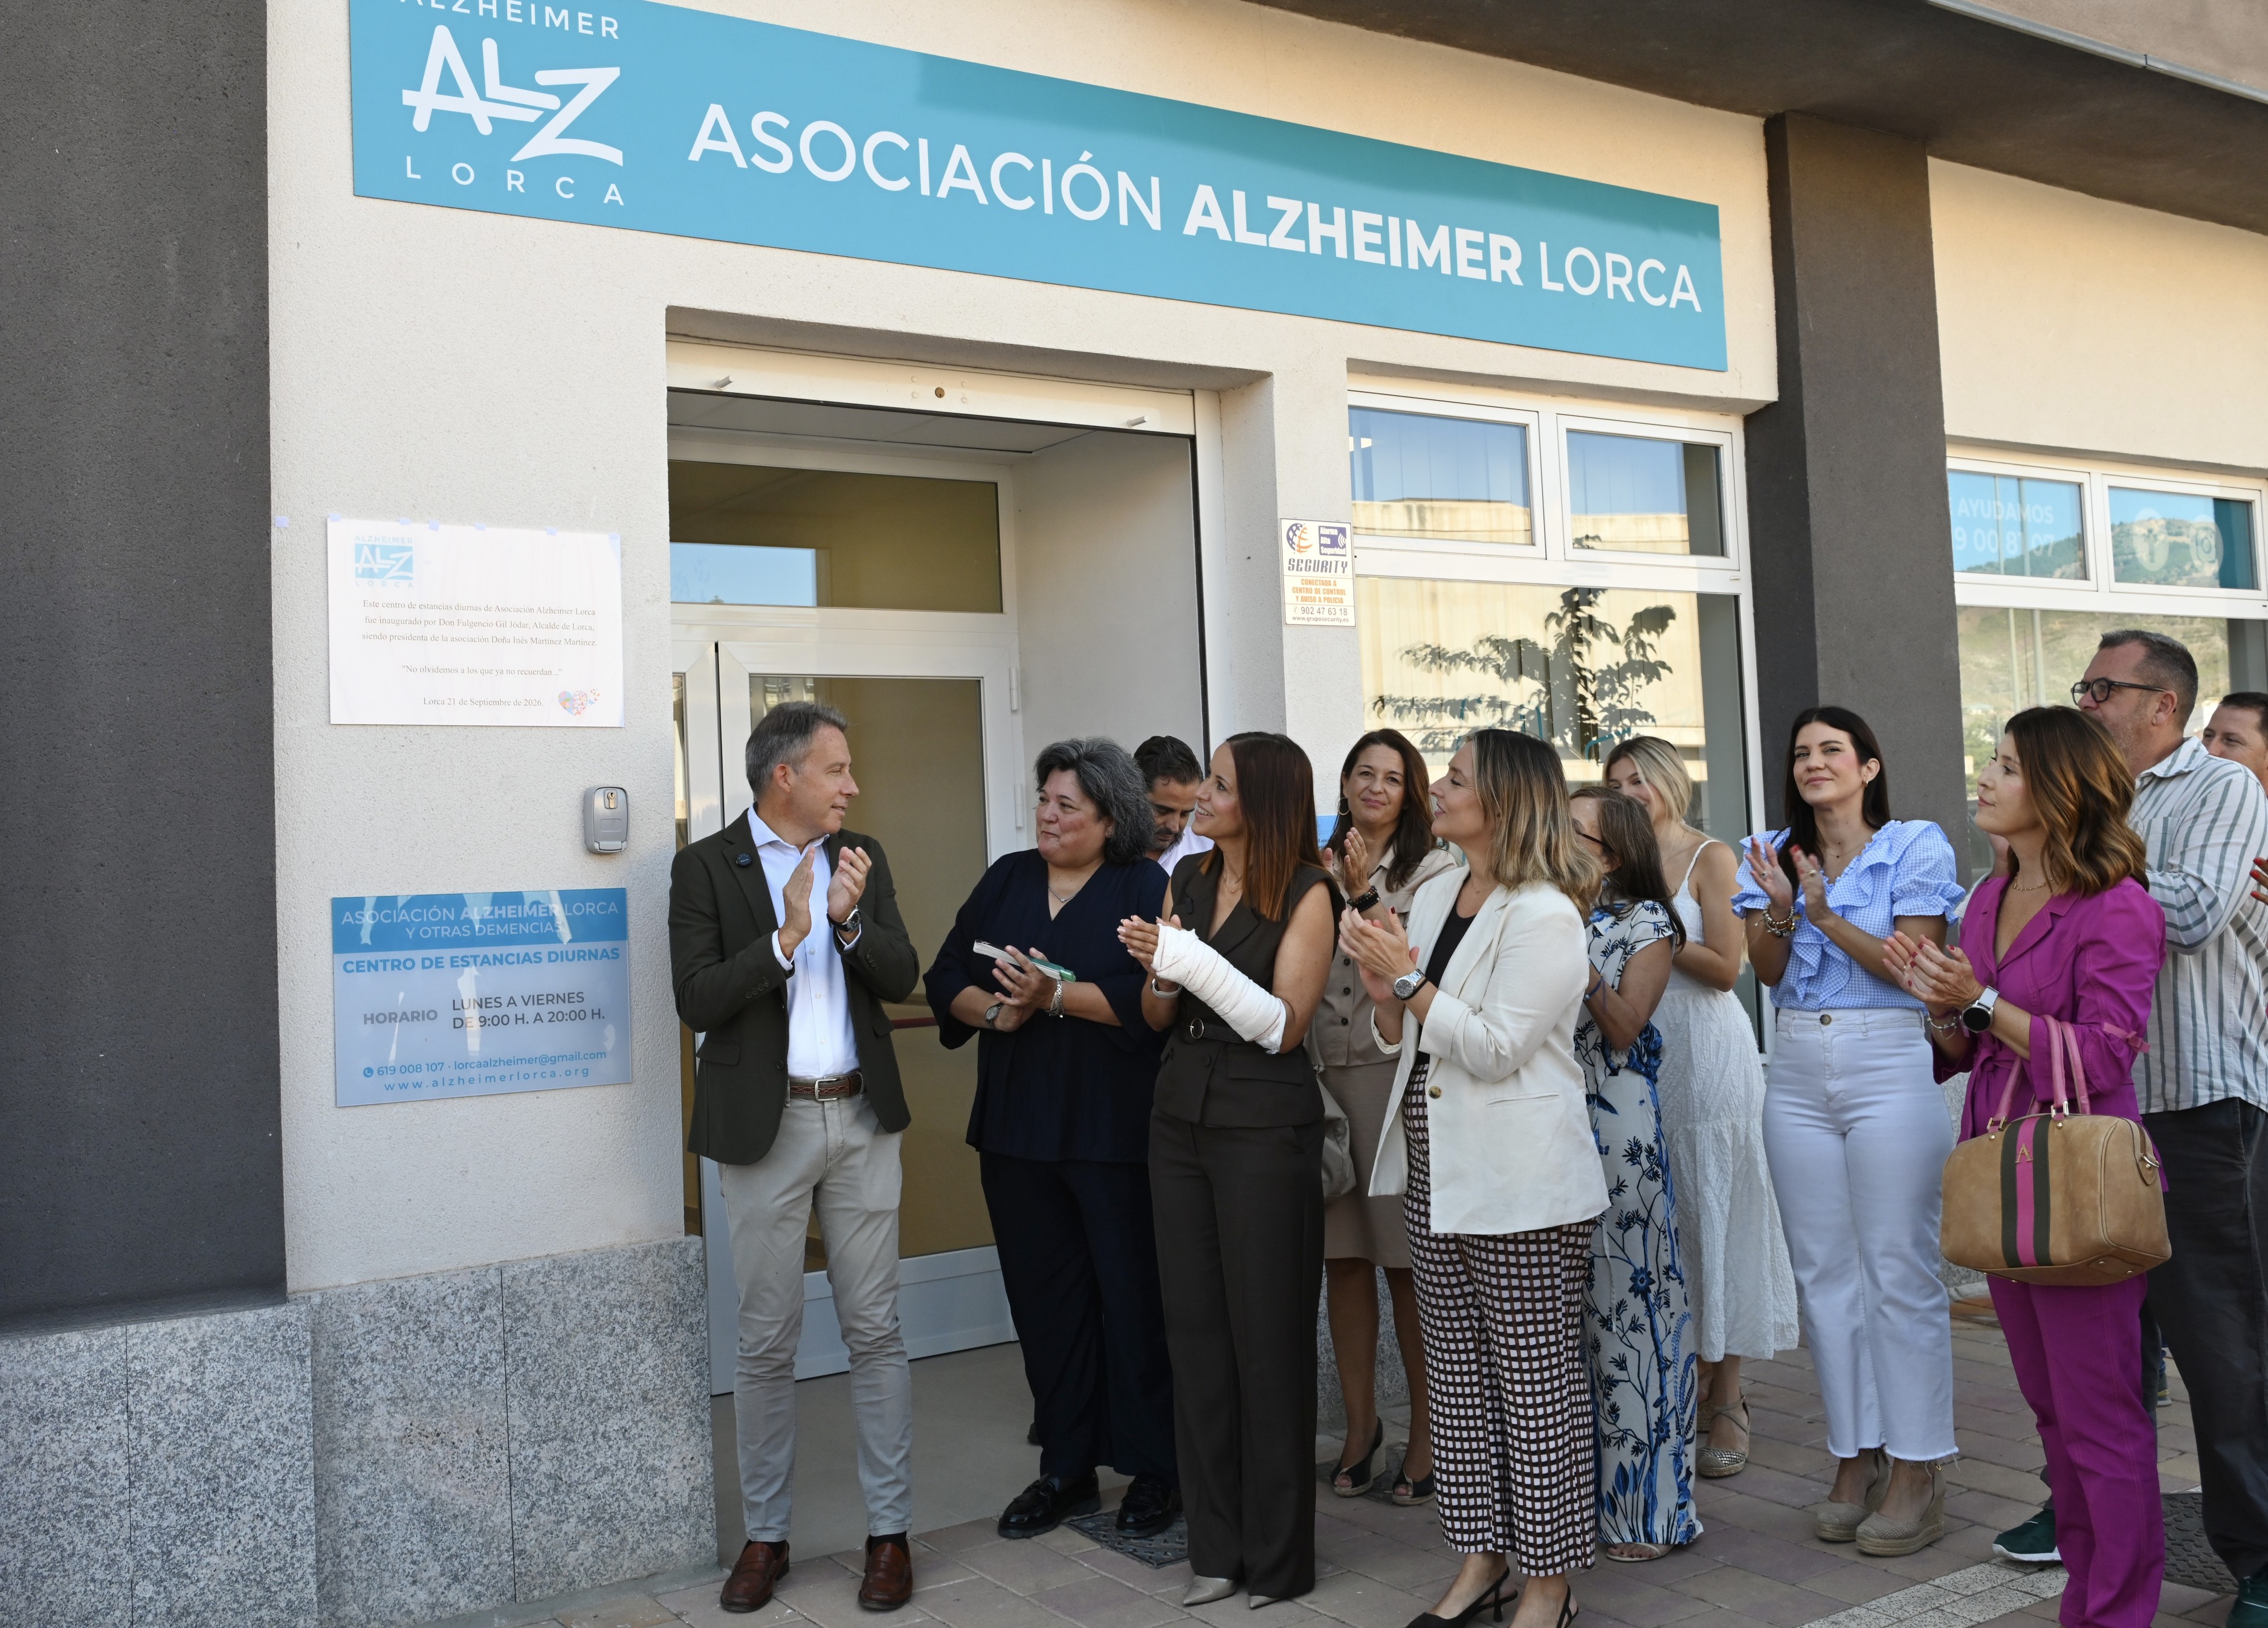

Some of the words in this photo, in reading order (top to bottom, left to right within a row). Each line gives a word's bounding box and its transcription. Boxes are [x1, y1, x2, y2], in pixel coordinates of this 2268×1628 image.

[400, 0, 619, 39] ZHEIMER
[402, 25, 623, 167] ALZ
[406, 156, 624, 206] LORCA
[688, 103, 1161, 231] ASOCIACIÓN
[1182, 184, 1523, 286] ALZHEIMER
[1540, 241, 1702, 312] LORCA
[1957, 498, 2054, 525] AYUDAMOS
[1320, 527, 1338, 535] Alarma
[1320, 546, 1346, 555] Seguridad
[355, 545, 413, 580] ALZ
[1288, 558, 1348, 574] SECURITY
[1301, 578, 1331, 587] CONECTADA
[363, 599, 380, 608] Este
[494, 605, 534, 613] Asociación
[1300, 606, 1314, 615] 902
[1316, 607, 1325, 615] 47
[1328, 607, 1337, 616] 63
[380, 616, 422, 626] inaugurado
[424, 619, 436, 627] por
[457, 619, 493, 628] Fulgencio
[509, 621, 531, 629] Jódar,
[572, 623, 595, 631] Lorca,
[389, 633, 428, 642] presidenta
[470, 698, 511, 707] Septiembre
[341, 905, 454, 925] ASOCIACIÓN
[460, 903, 560, 920] ALZHEIMER
[564, 901, 619, 916] LORCA
[405, 927, 416, 939] Y
[419, 925, 470, 938] OTRAS
[475, 921, 562, 936] DEMENCIAS
[343, 957, 416, 974] CENTRO
[422, 956, 445, 970] DE
[450, 951, 543, 968] ESTANCIAS
[547, 947, 620, 963] DIURNAS
[452, 996, 502, 1012] LUNES
[506, 995, 517, 1008] A
[521, 991, 585, 1007] VIERNES
[363, 1009, 439, 1026] HORARIO
[453, 1016, 474, 1029] DE
[478, 1014, 509, 1027] 9:00
[515, 1013, 529, 1025] H.
[532, 1011, 544, 1024] A
[547, 1009, 586, 1023] 20:00
[591, 1007, 605, 1020] H.
[377, 1065, 396, 1076] 619
[399, 1063, 422, 1074] 008
[425, 1062, 445, 1073] 107
[454, 1050, 607, 1071] lorcaalzheimer@gmail.com
[384, 1067, 590, 1091] www.alzheimerlorca.org
